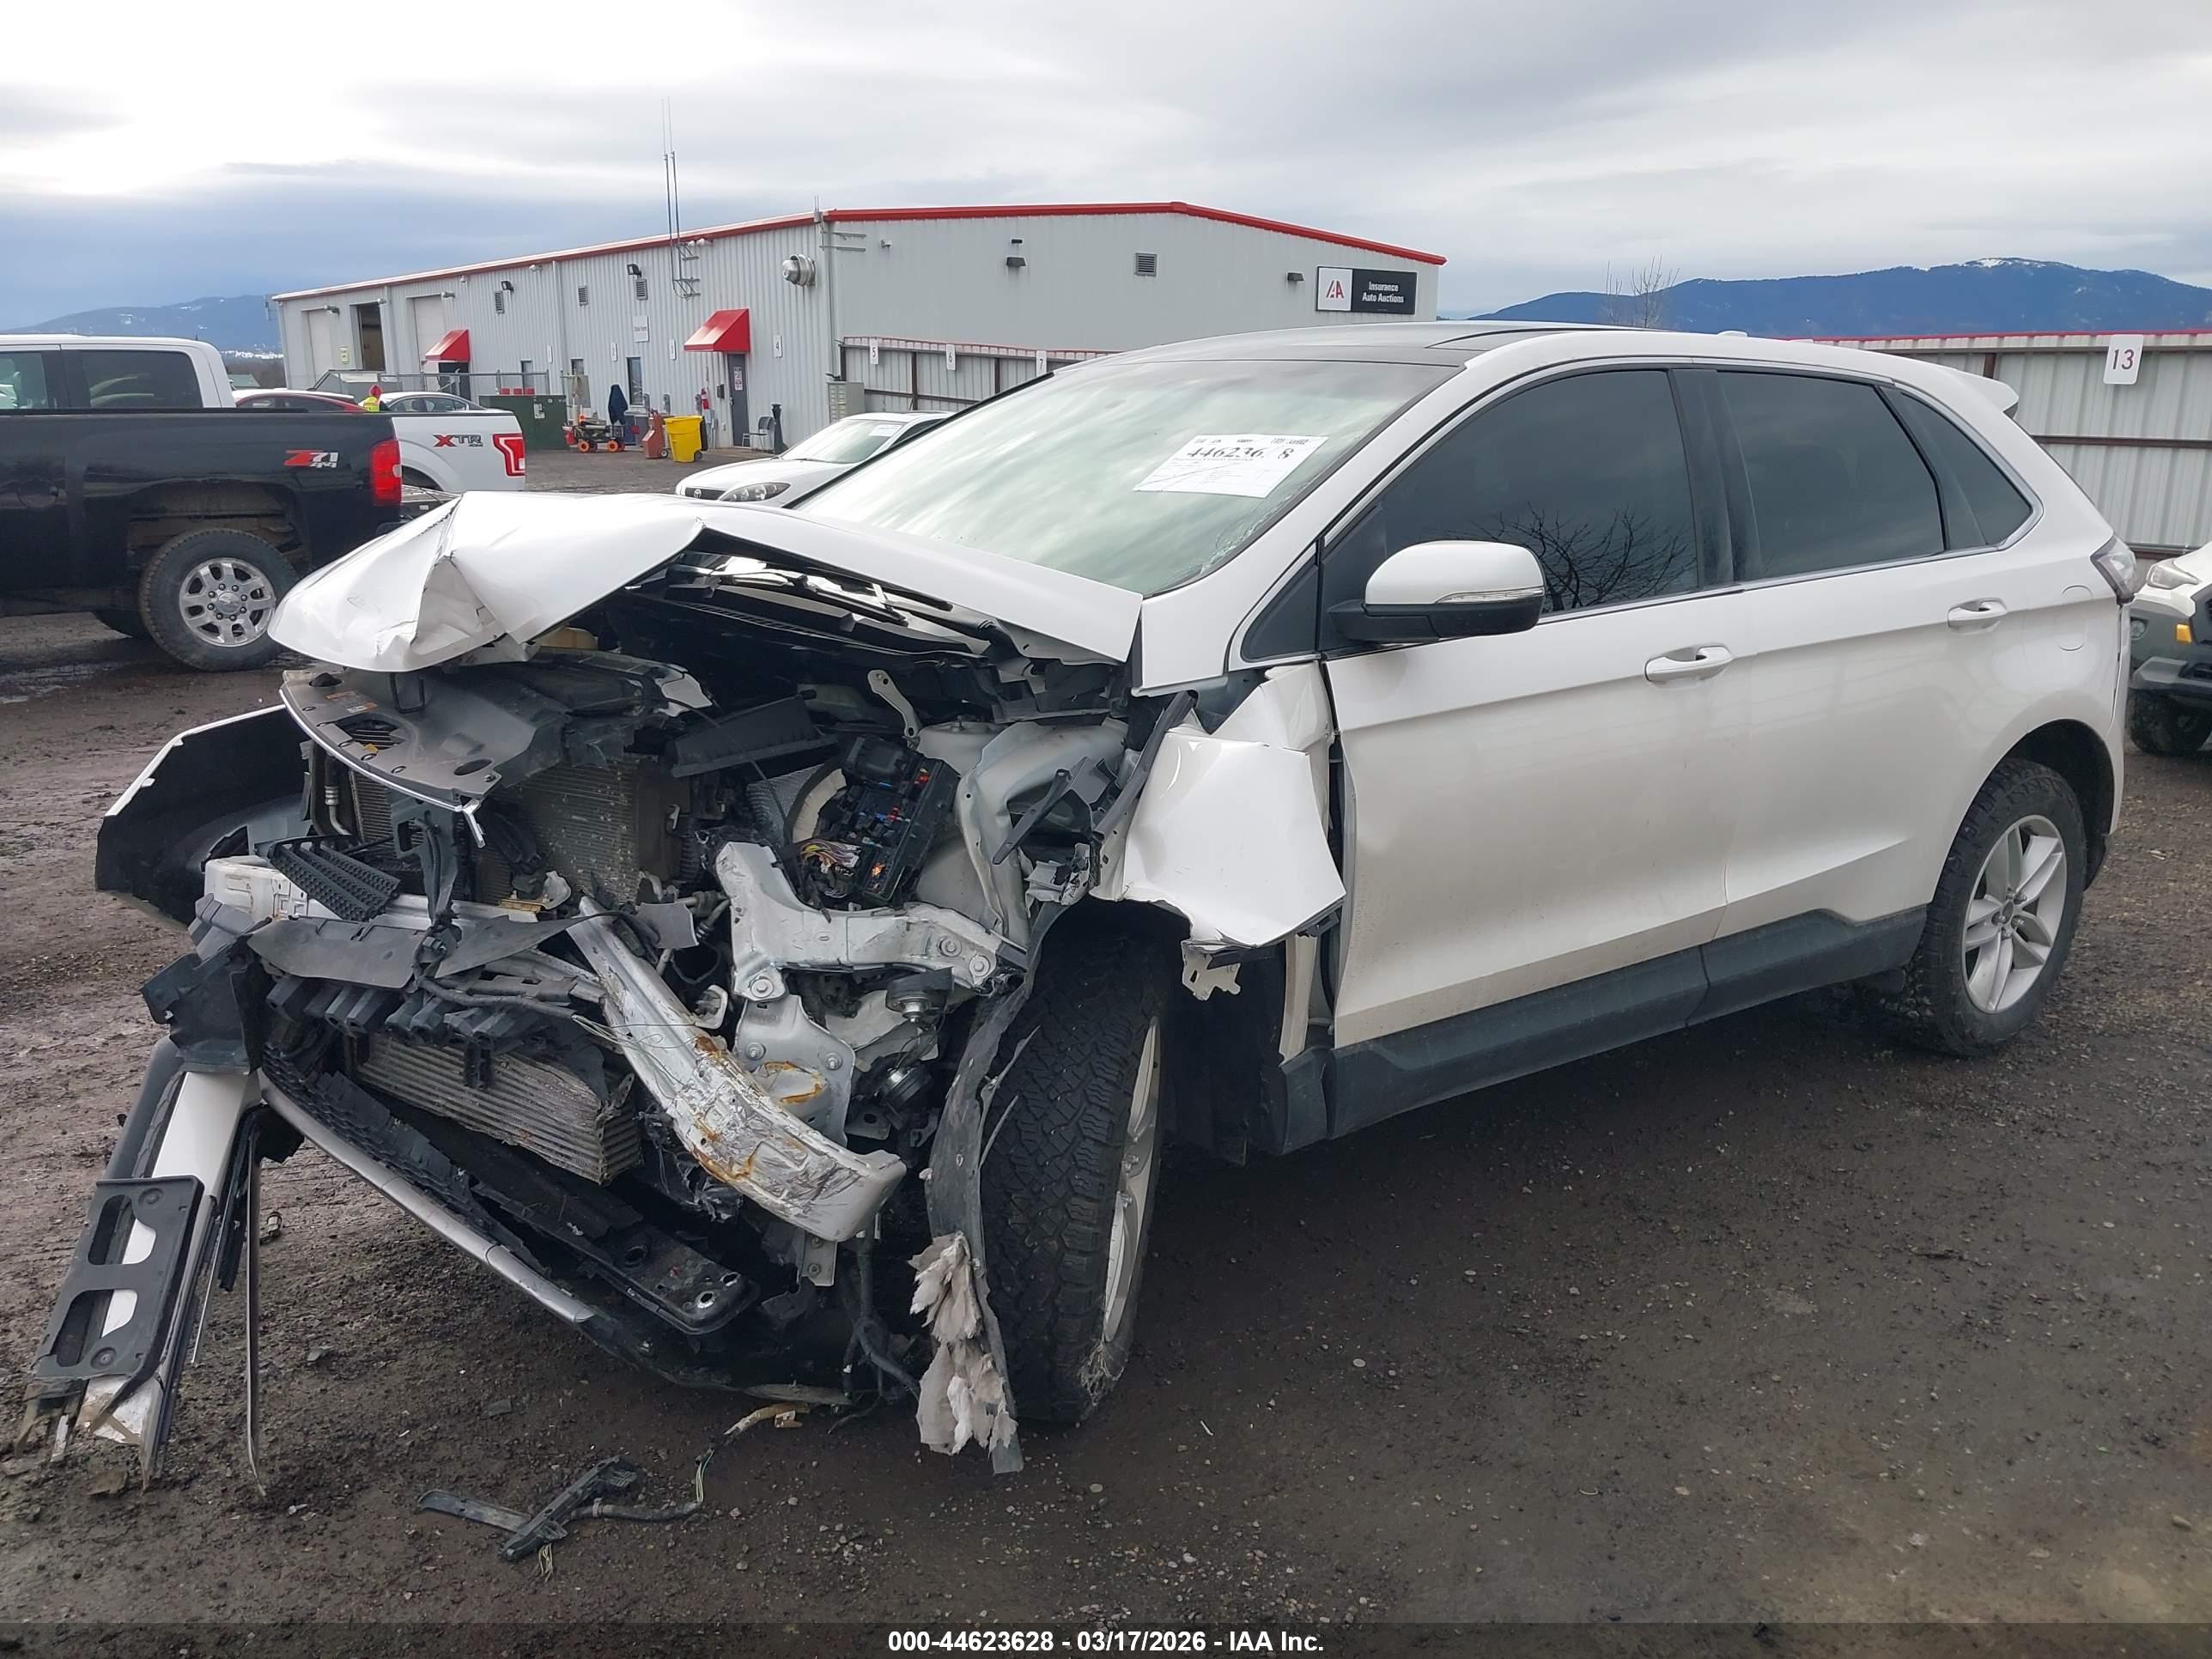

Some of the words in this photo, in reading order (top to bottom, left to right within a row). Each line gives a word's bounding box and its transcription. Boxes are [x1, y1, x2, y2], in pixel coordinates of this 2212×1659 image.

[1369, 282, 1399, 291] Insurance
[1362, 292, 1376, 301] Auto
[1378, 293, 1404, 303] Auctions
[872, 348, 877, 358] 5
[949, 352, 953, 362] 6
[1039, 358, 1043, 371] 7
[2112, 349, 2135, 370] 13
[433, 434, 482, 447] XTR
[284, 449, 338, 467] Z71
